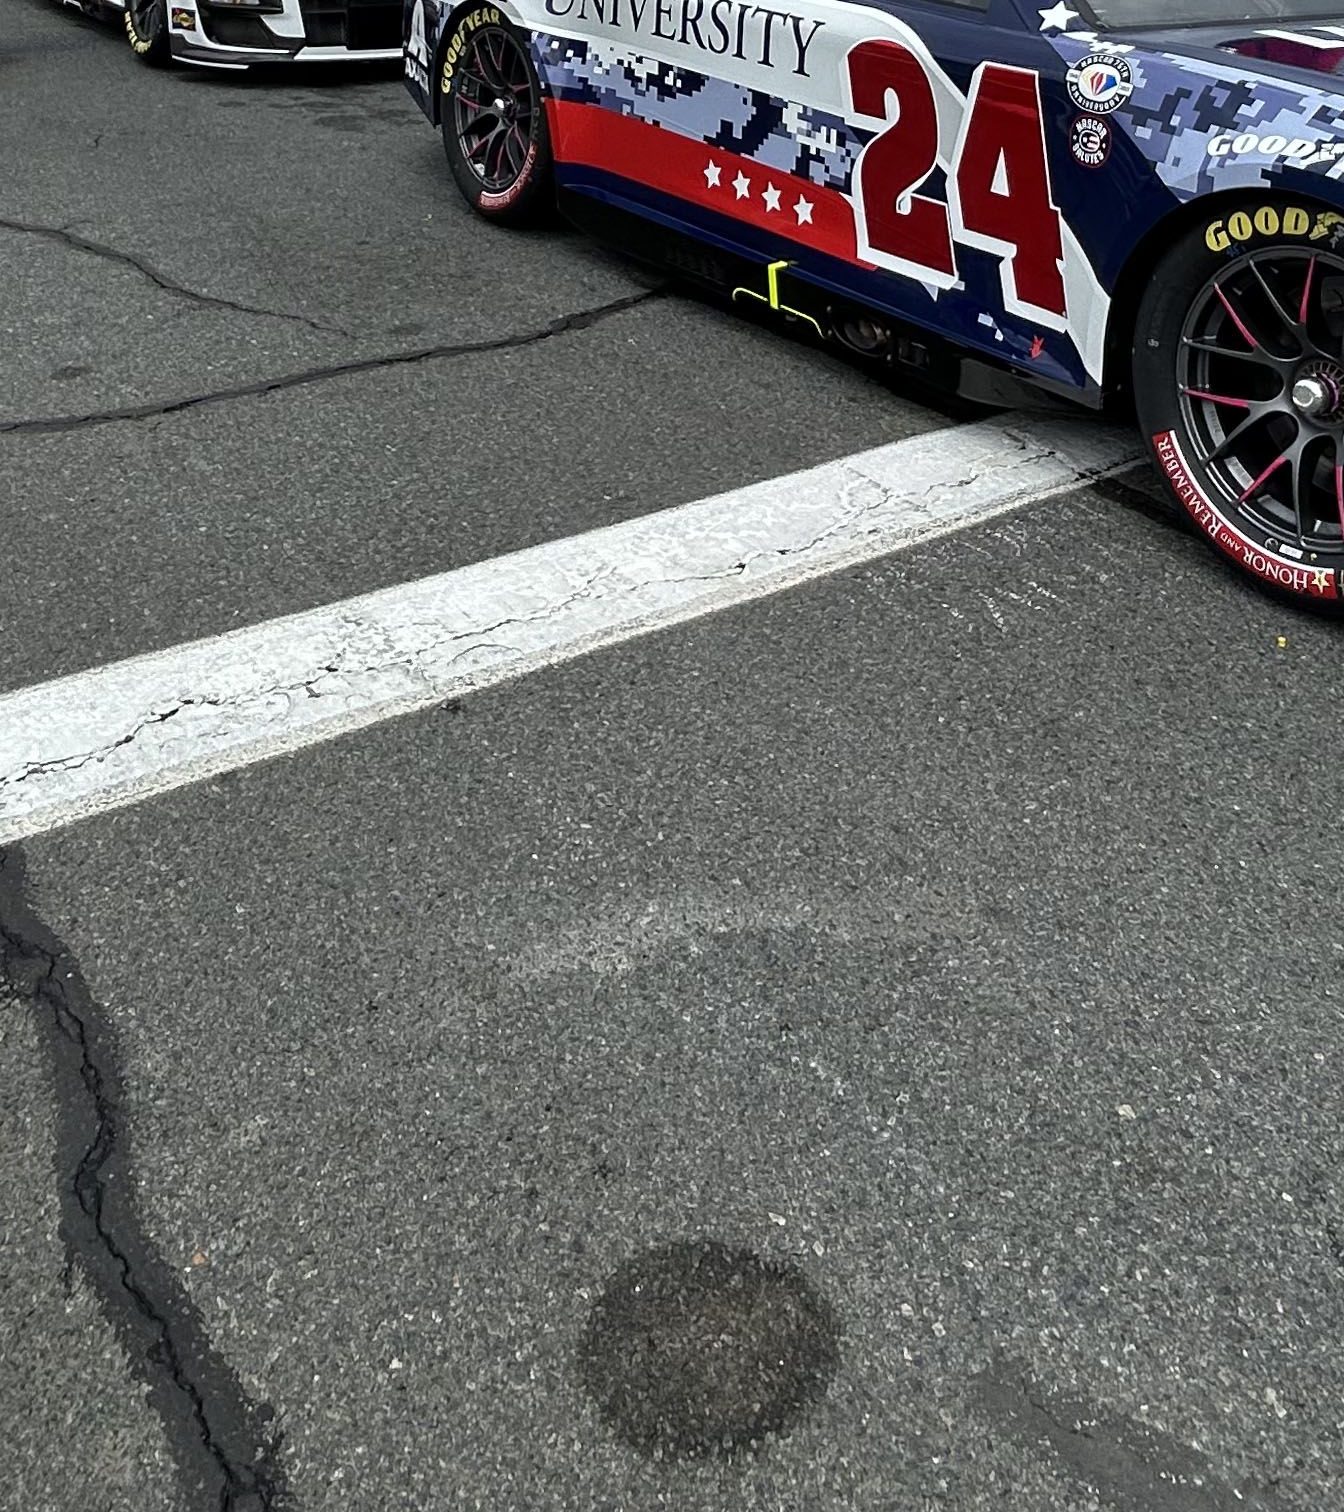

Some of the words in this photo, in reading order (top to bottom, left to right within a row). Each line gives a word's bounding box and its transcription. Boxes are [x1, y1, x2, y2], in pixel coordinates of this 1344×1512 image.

[1076, 118, 1108, 139] NASCAR
[1072, 142, 1105, 164] SALUTES
[846, 38, 1069, 332] 24
[1157, 436, 1223, 539] REMEMBER
[1219, 533, 1243, 552] AND
[1242, 548, 1309, 589] HONOR
